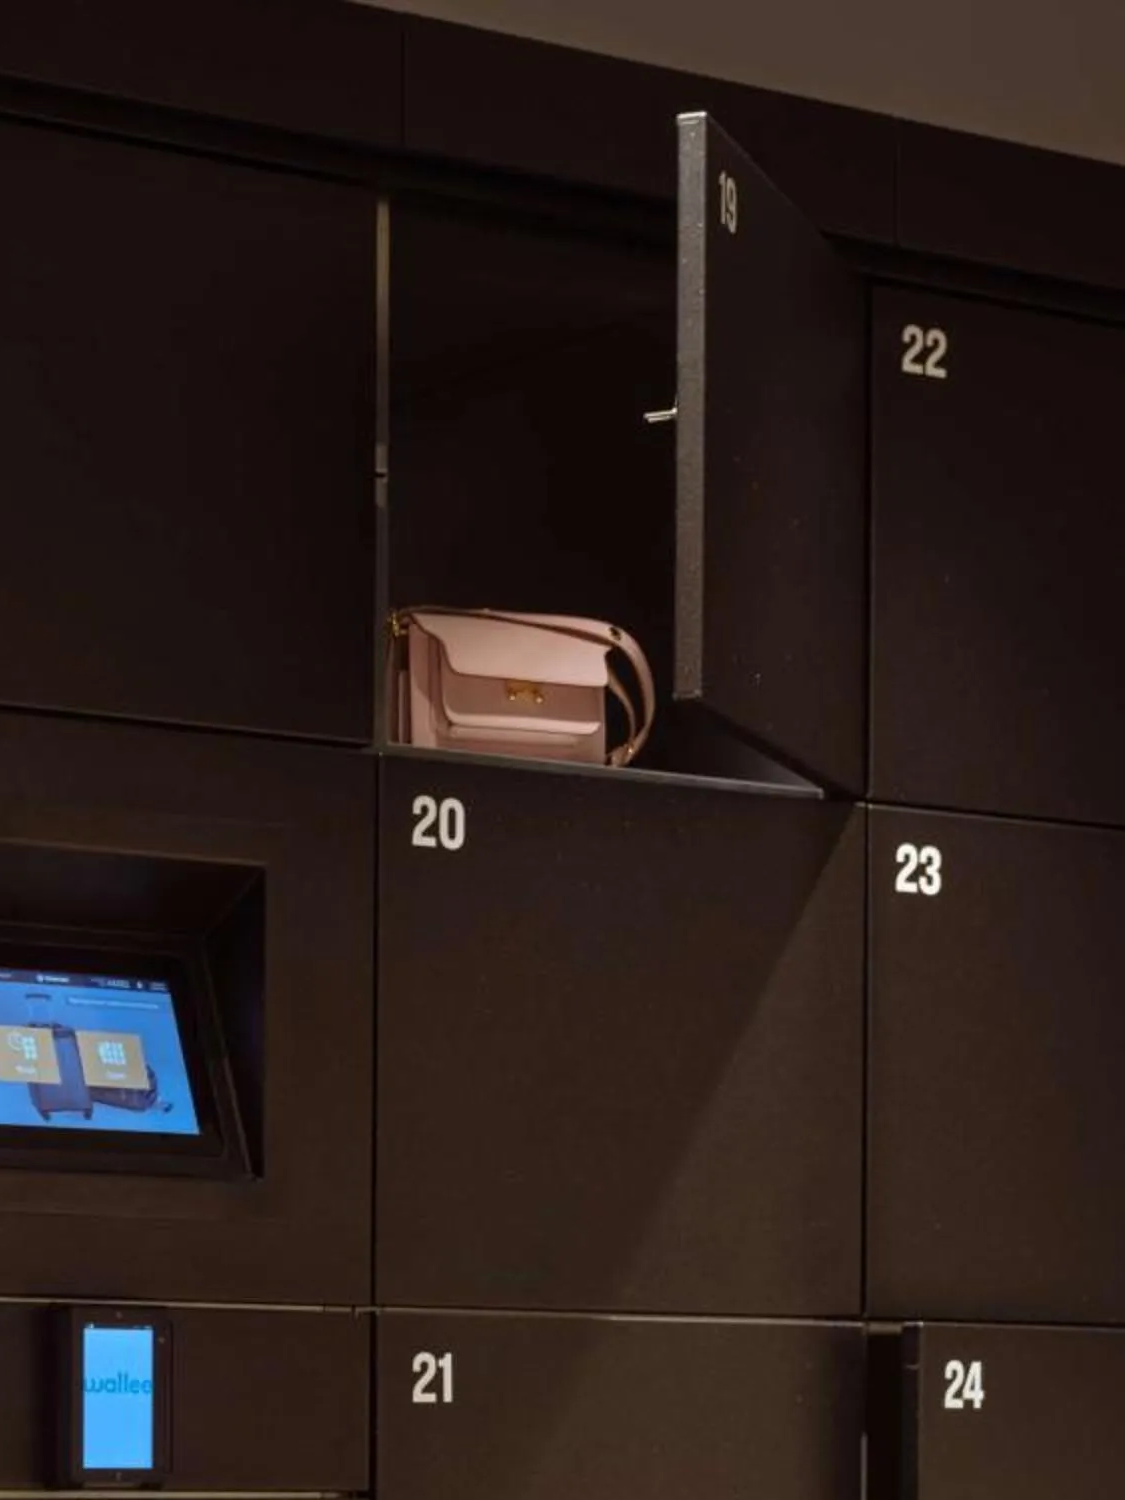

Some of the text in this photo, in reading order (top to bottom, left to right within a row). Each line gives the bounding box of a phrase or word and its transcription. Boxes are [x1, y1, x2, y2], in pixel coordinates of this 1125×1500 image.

[719, 171, 737, 234] 19
[901, 324, 947, 379] 22
[412, 795, 465, 850] 20
[895, 843, 942, 896] 23
[412, 1351, 453, 1403] 21
[944, 1359, 985, 1409] 24
